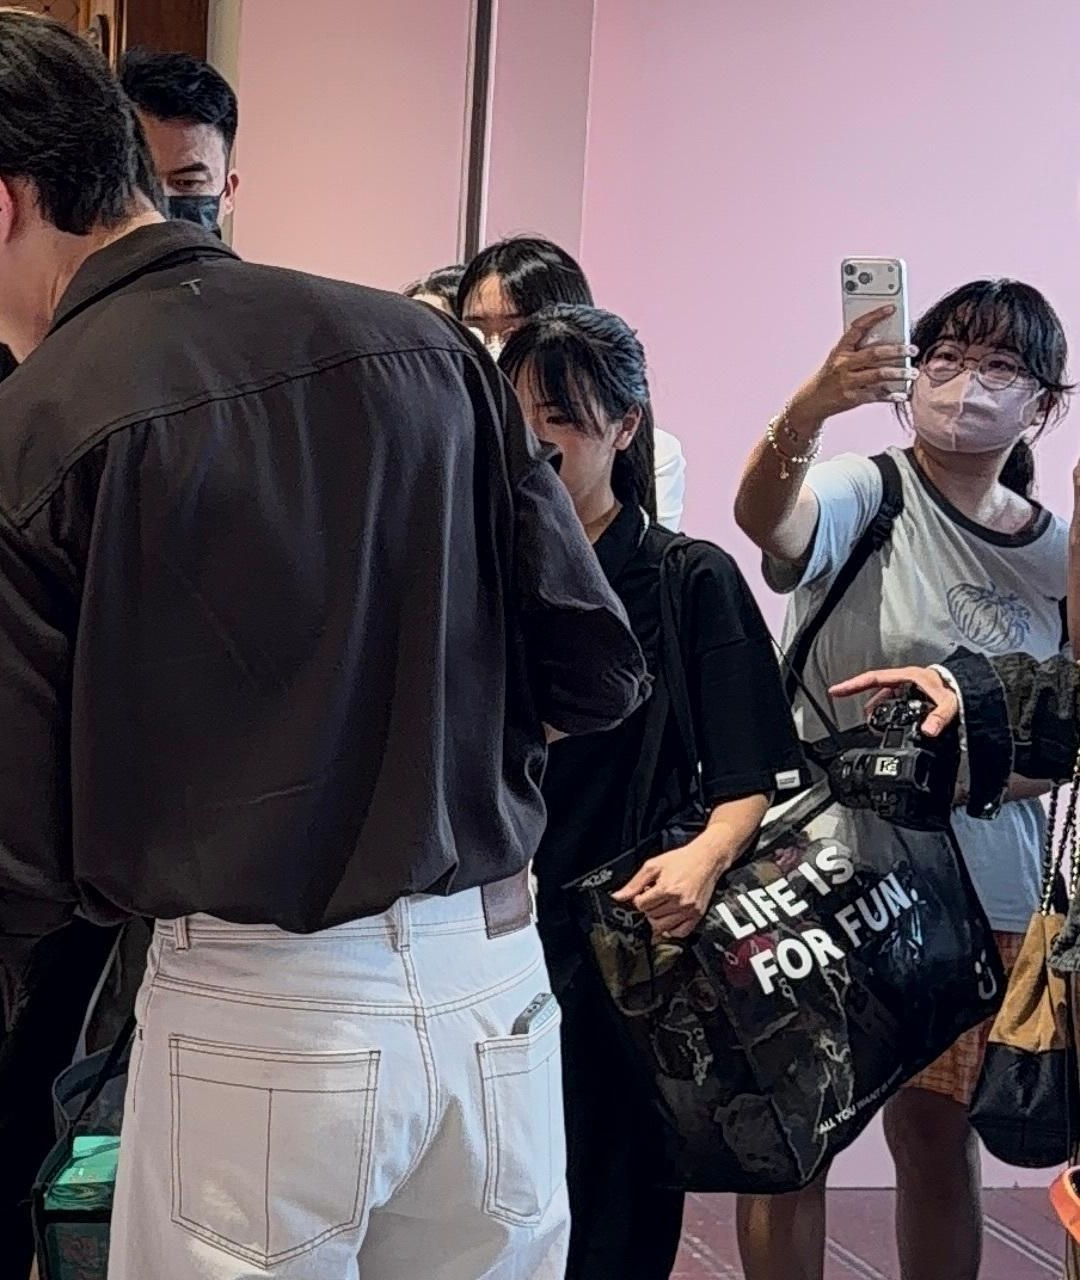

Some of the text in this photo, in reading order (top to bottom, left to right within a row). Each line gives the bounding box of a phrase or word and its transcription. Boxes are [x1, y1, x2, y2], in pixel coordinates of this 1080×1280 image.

[716, 846, 854, 940] LIFE IS
[749, 871, 919, 995] FOR FUN.
